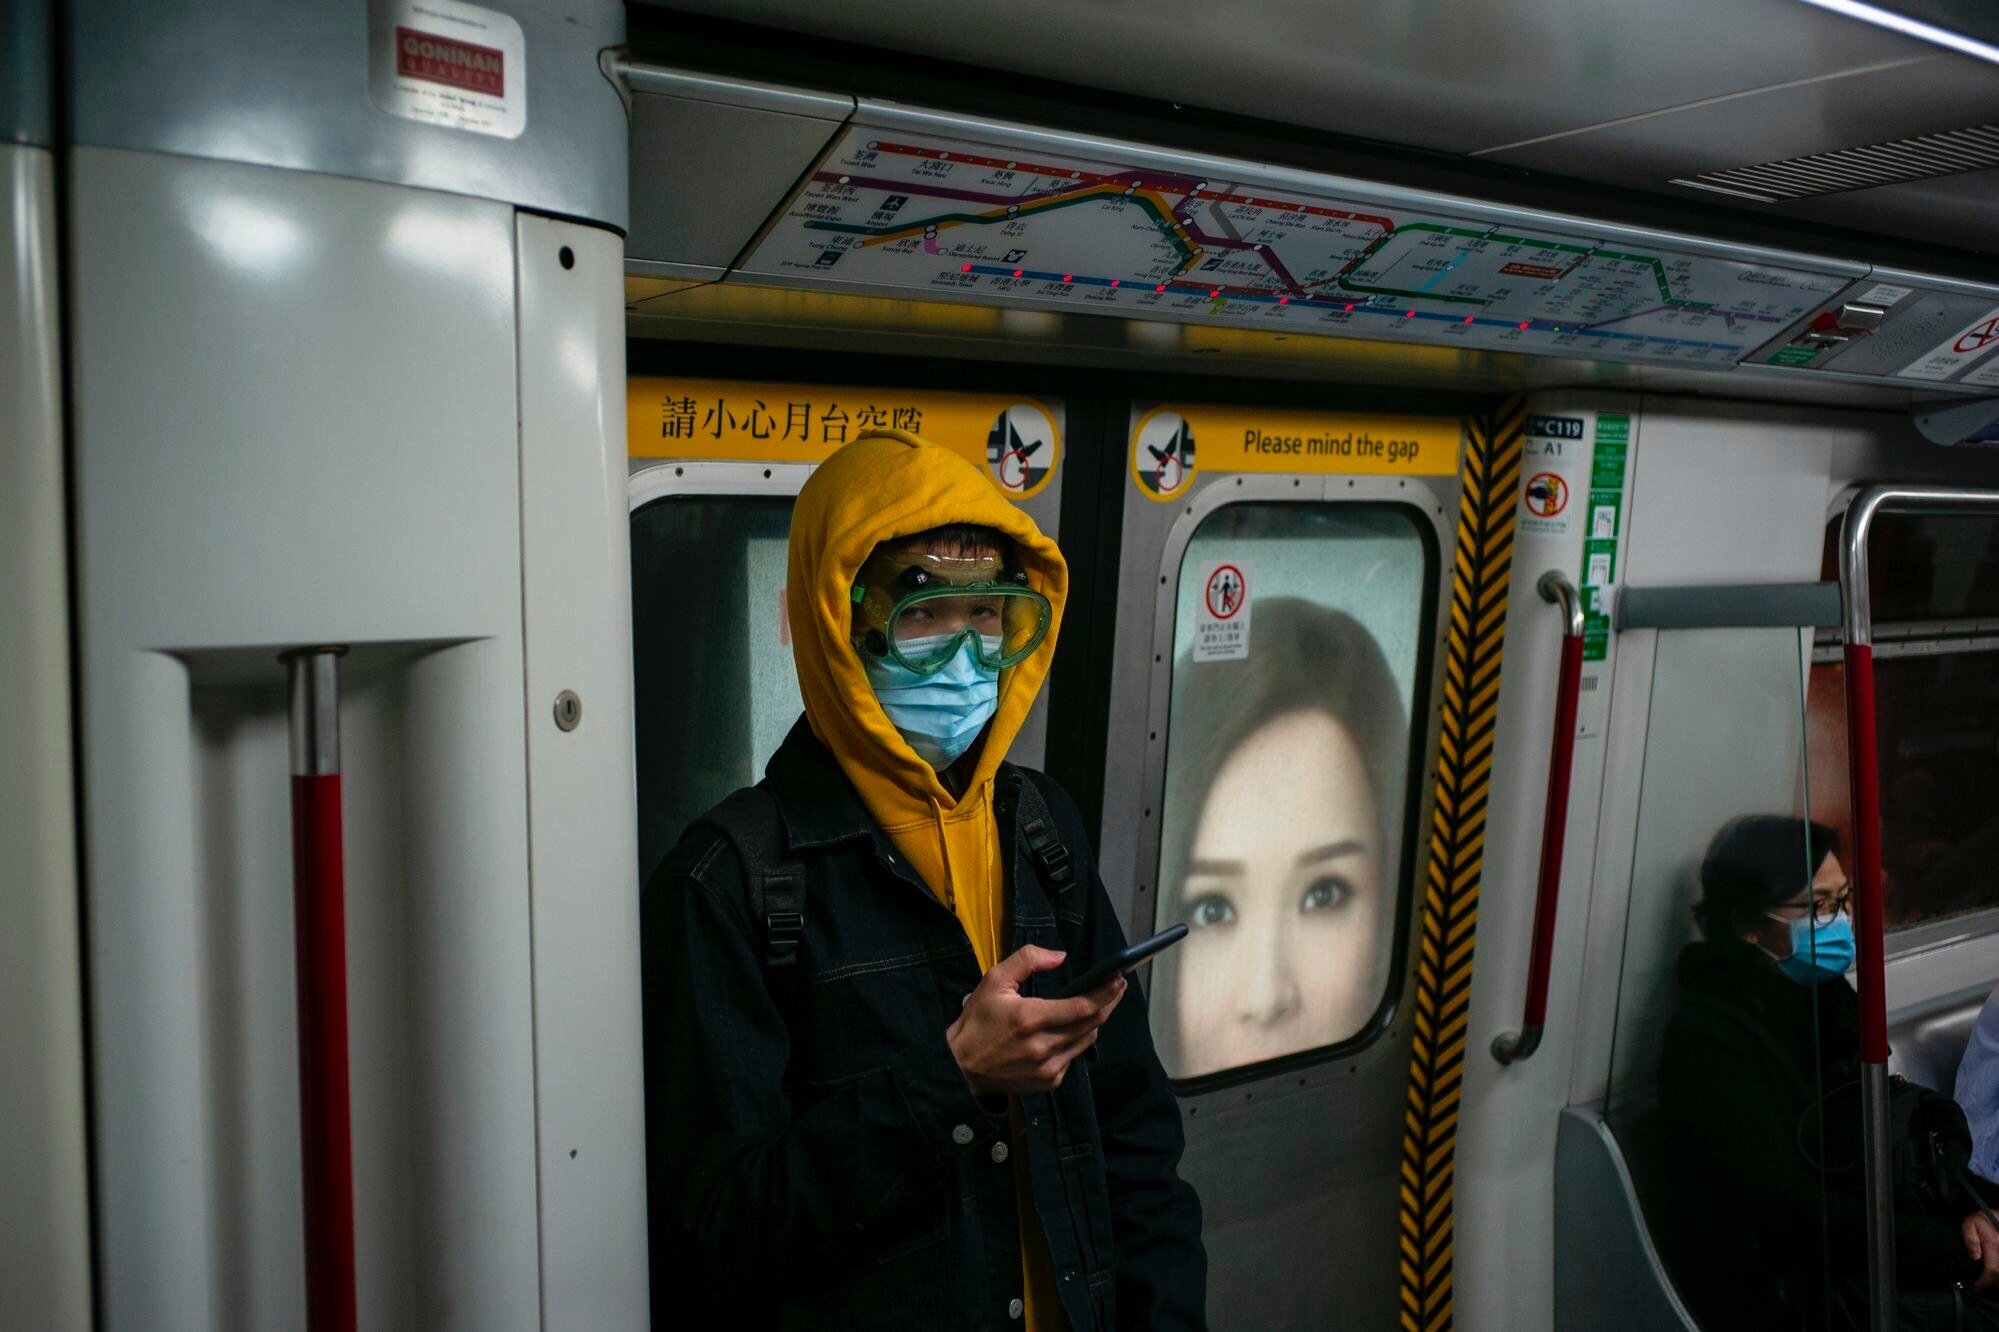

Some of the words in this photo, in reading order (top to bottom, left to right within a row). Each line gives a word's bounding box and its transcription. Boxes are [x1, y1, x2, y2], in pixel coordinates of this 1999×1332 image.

[403, 36, 500, 74] GONINAN
[661, 395, 923, 443] 請小心月台空隙
[1545, 420, 1581, 437] C119
[1244, 430, 1302, 454] Please
[1307, 432, 1352, 456] mind
[1357, 432, 1384, 457] the
[1388, 440, 1419, 463] gap
[1544, 441, 1562, 456] A1
